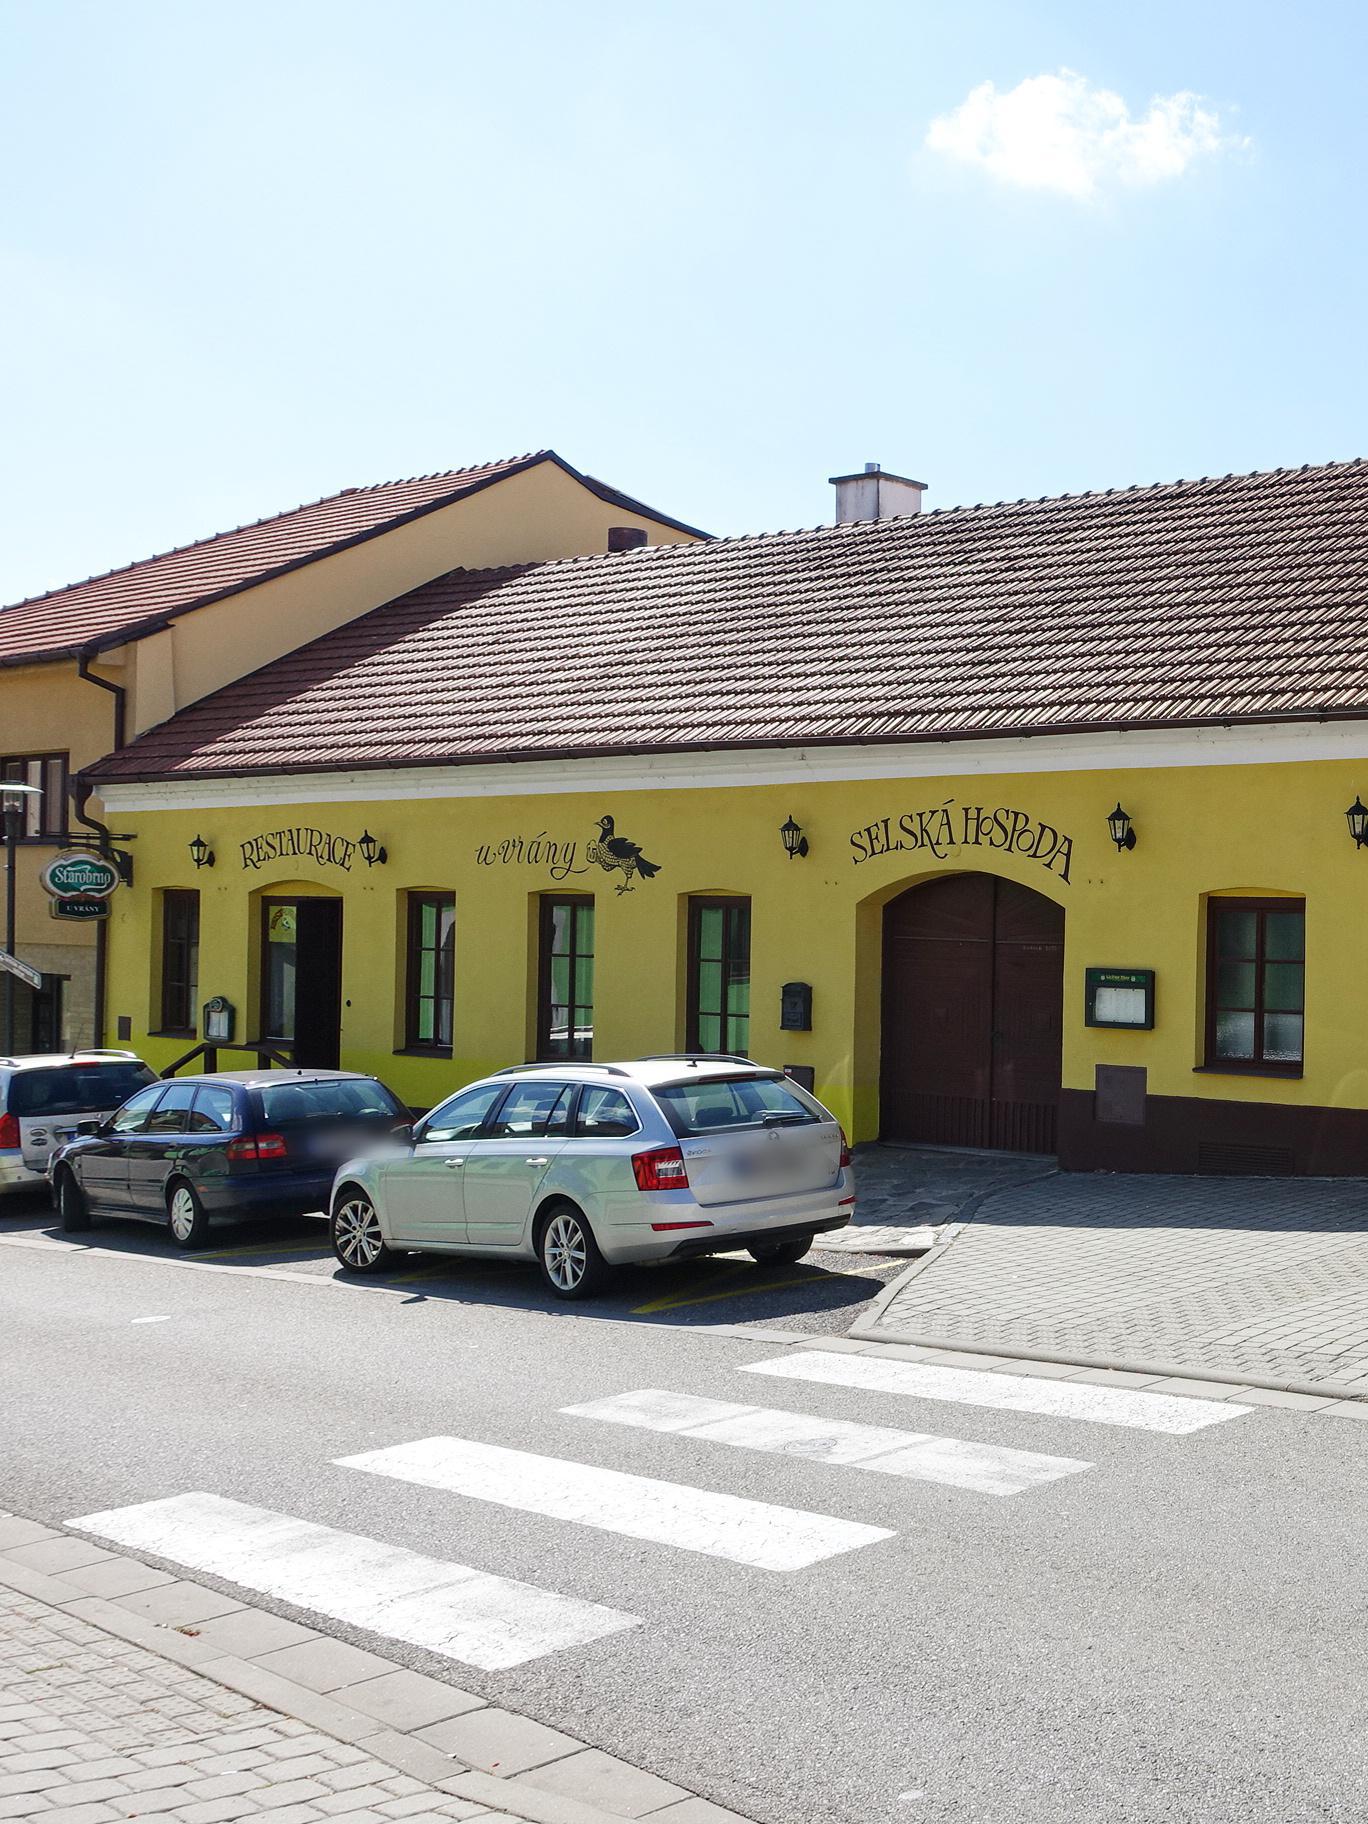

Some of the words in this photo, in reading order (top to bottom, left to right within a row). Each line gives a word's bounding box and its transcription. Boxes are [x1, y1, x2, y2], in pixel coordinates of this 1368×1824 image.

[239, 827, 356, 873] RESTAURACE
[850, 798, 956, 865] SELSKÁ
[55, 865, 111, 891] Starobrno
